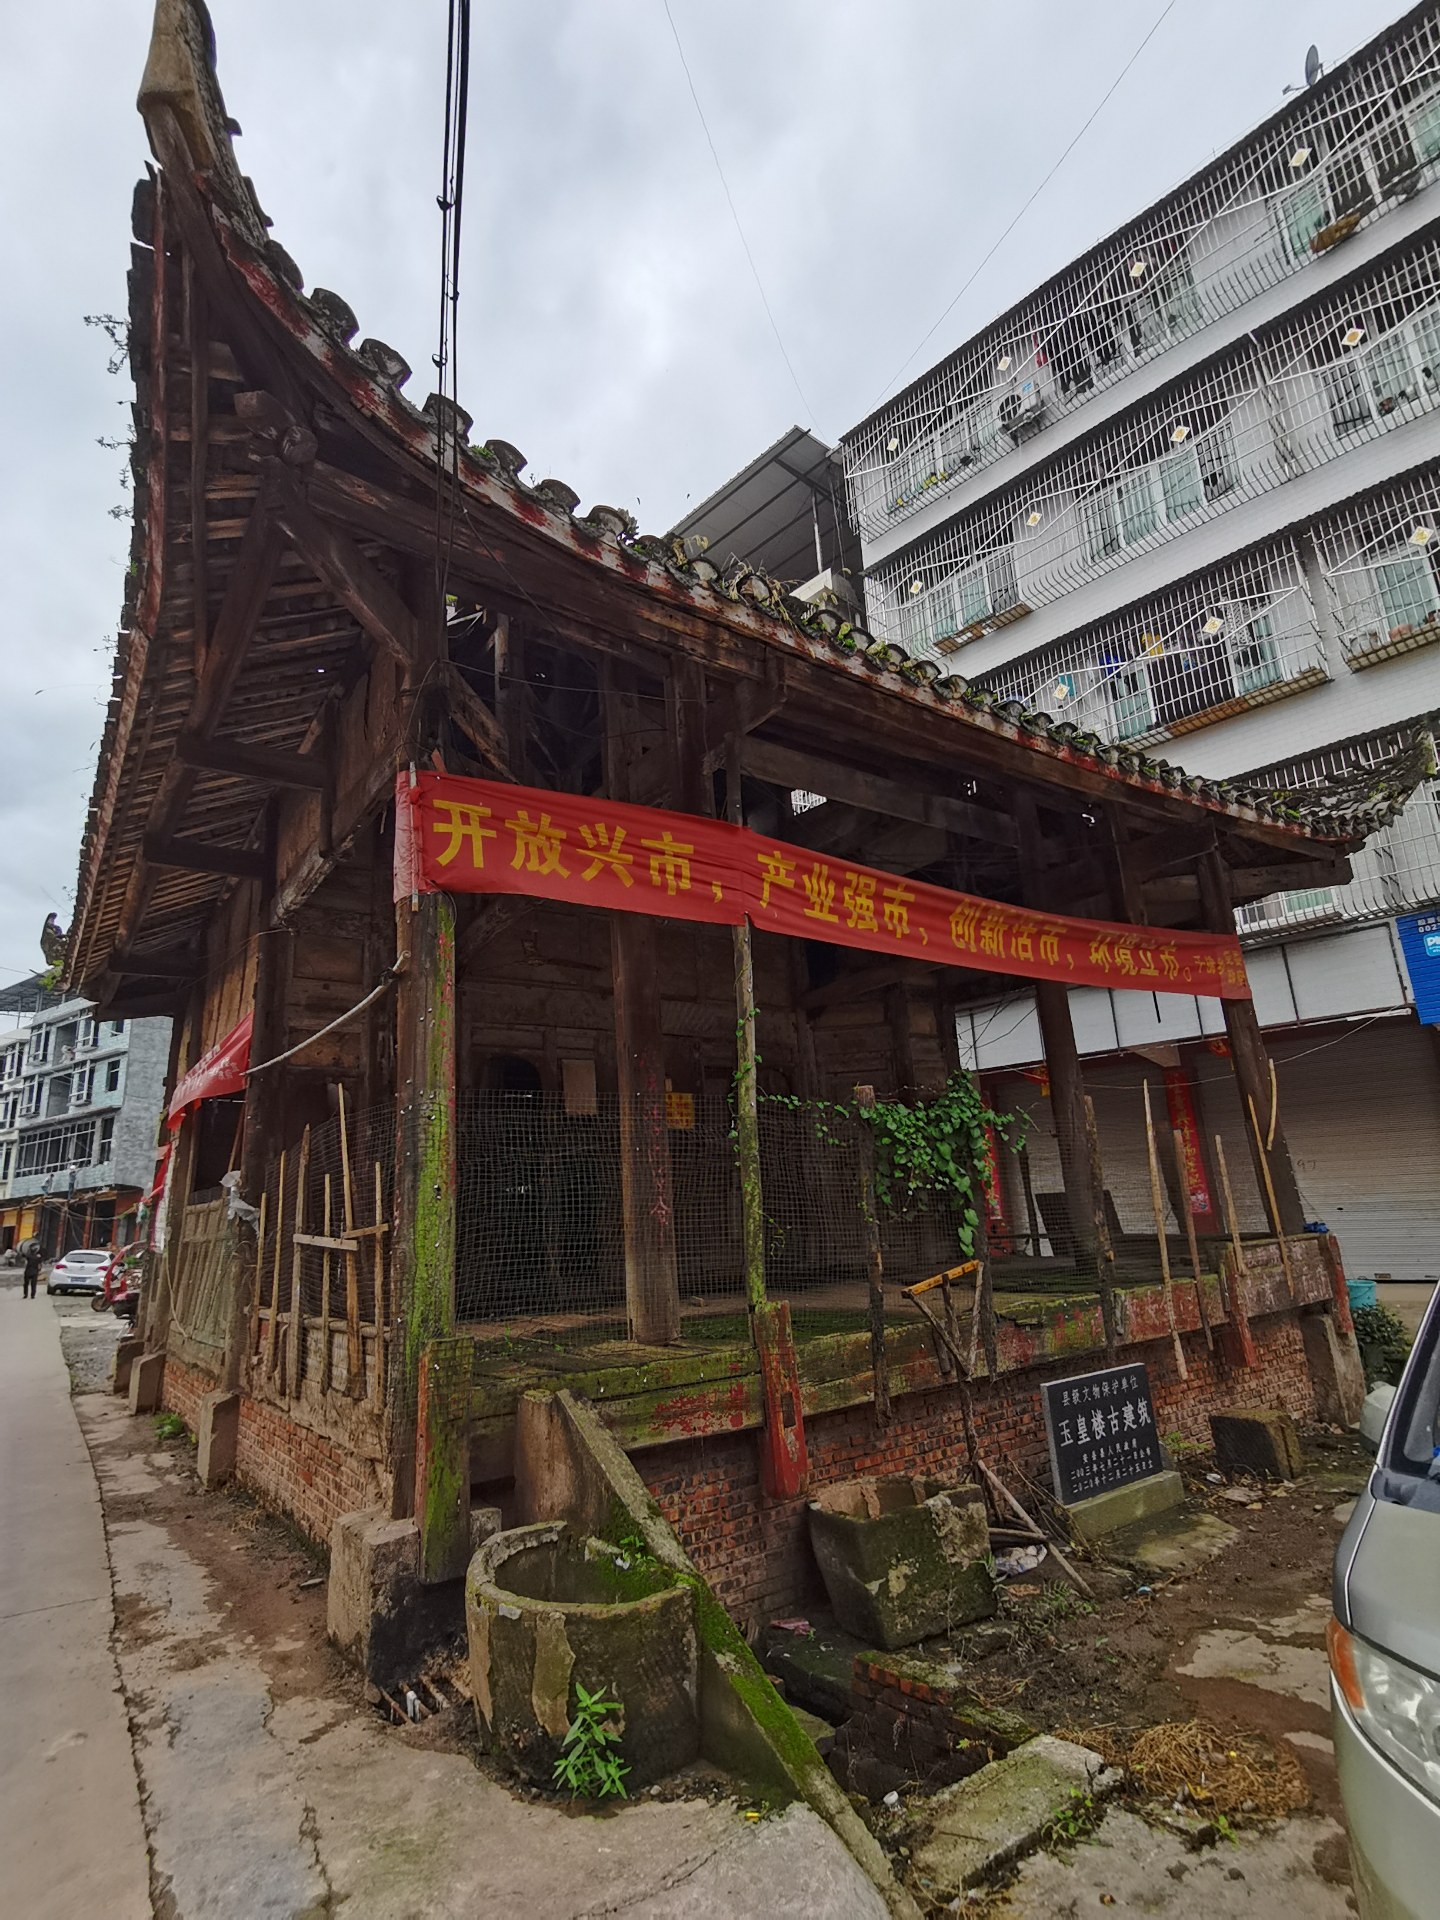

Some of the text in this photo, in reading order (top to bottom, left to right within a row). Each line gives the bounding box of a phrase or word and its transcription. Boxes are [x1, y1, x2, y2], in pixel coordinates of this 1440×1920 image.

[1062, 1375, 1139, 1407] 县级文物保护单位
[1057, 1396, 1152, 1447] 玉皇楼古建筑
